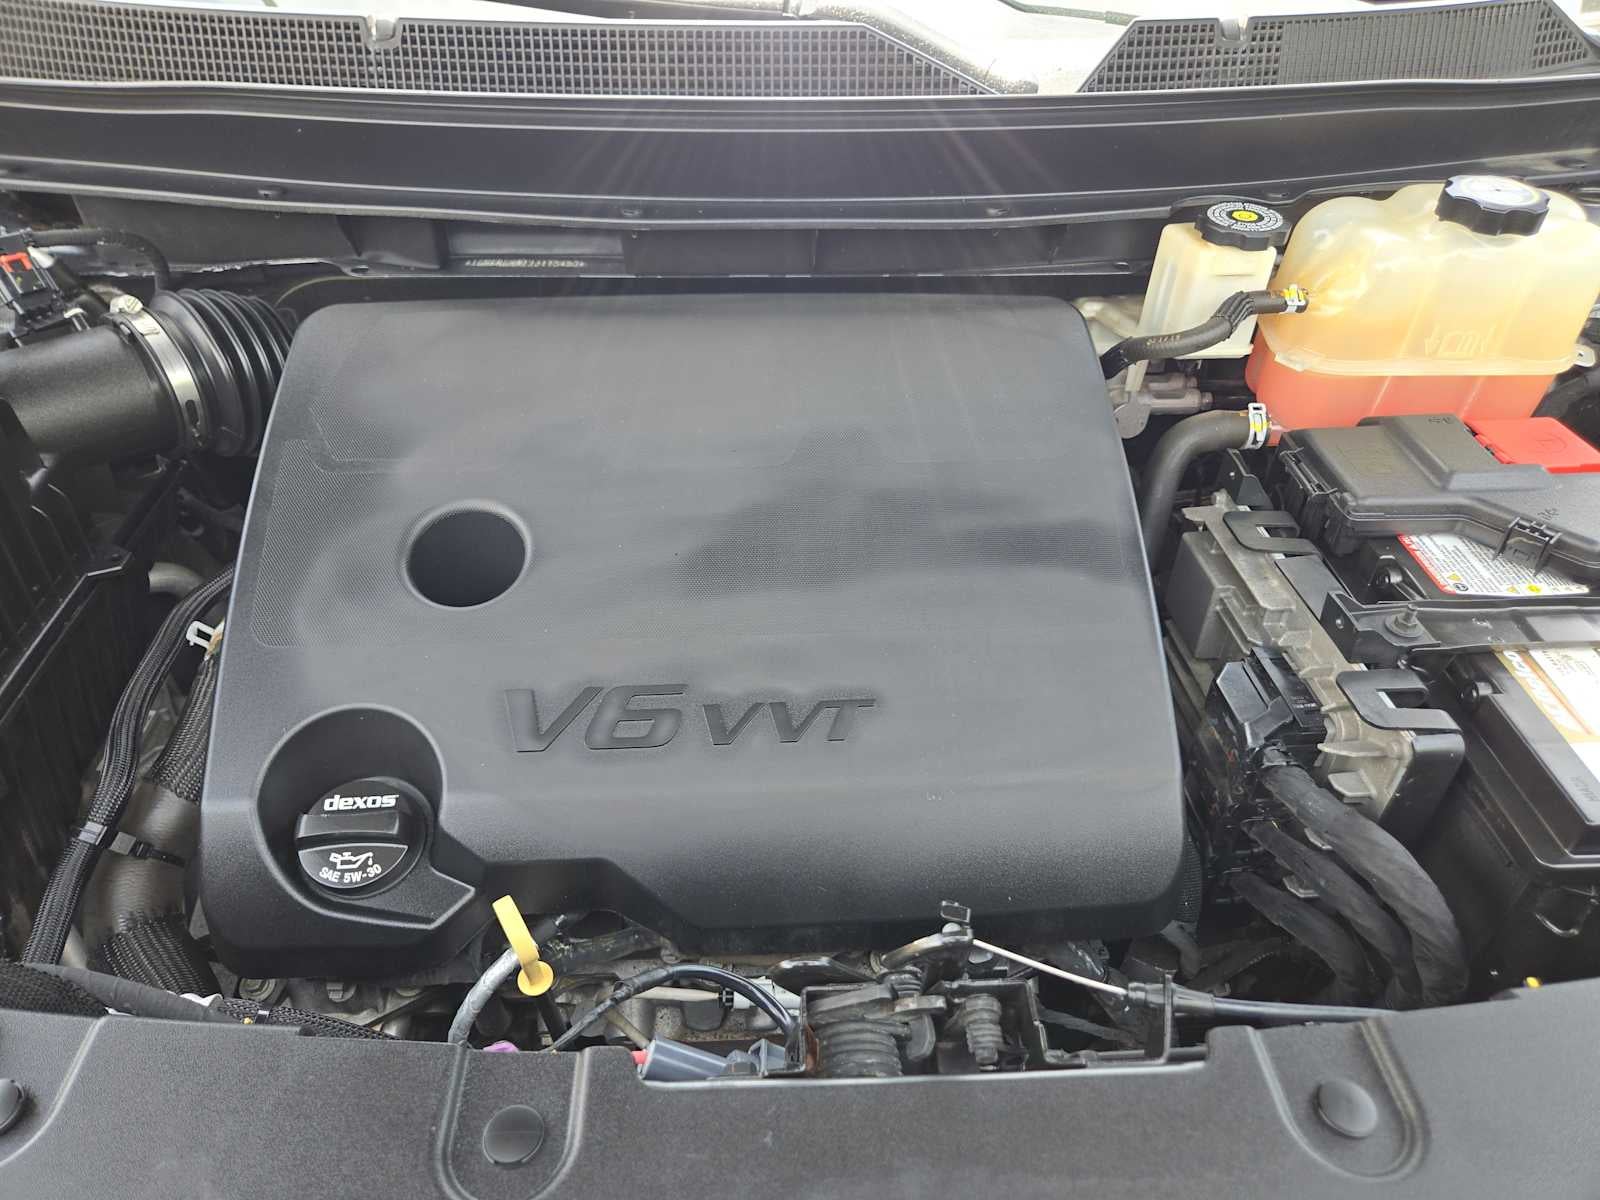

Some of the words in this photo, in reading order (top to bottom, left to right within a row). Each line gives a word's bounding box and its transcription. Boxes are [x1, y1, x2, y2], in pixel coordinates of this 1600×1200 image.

[504, 683, 689, 753] V6
[702, 698, 877, 746] VVT
[323, 794, 399, 811] dexos
[319, 866, 341, 882] SAE
[343, 864, 382, 883] 5W-30
